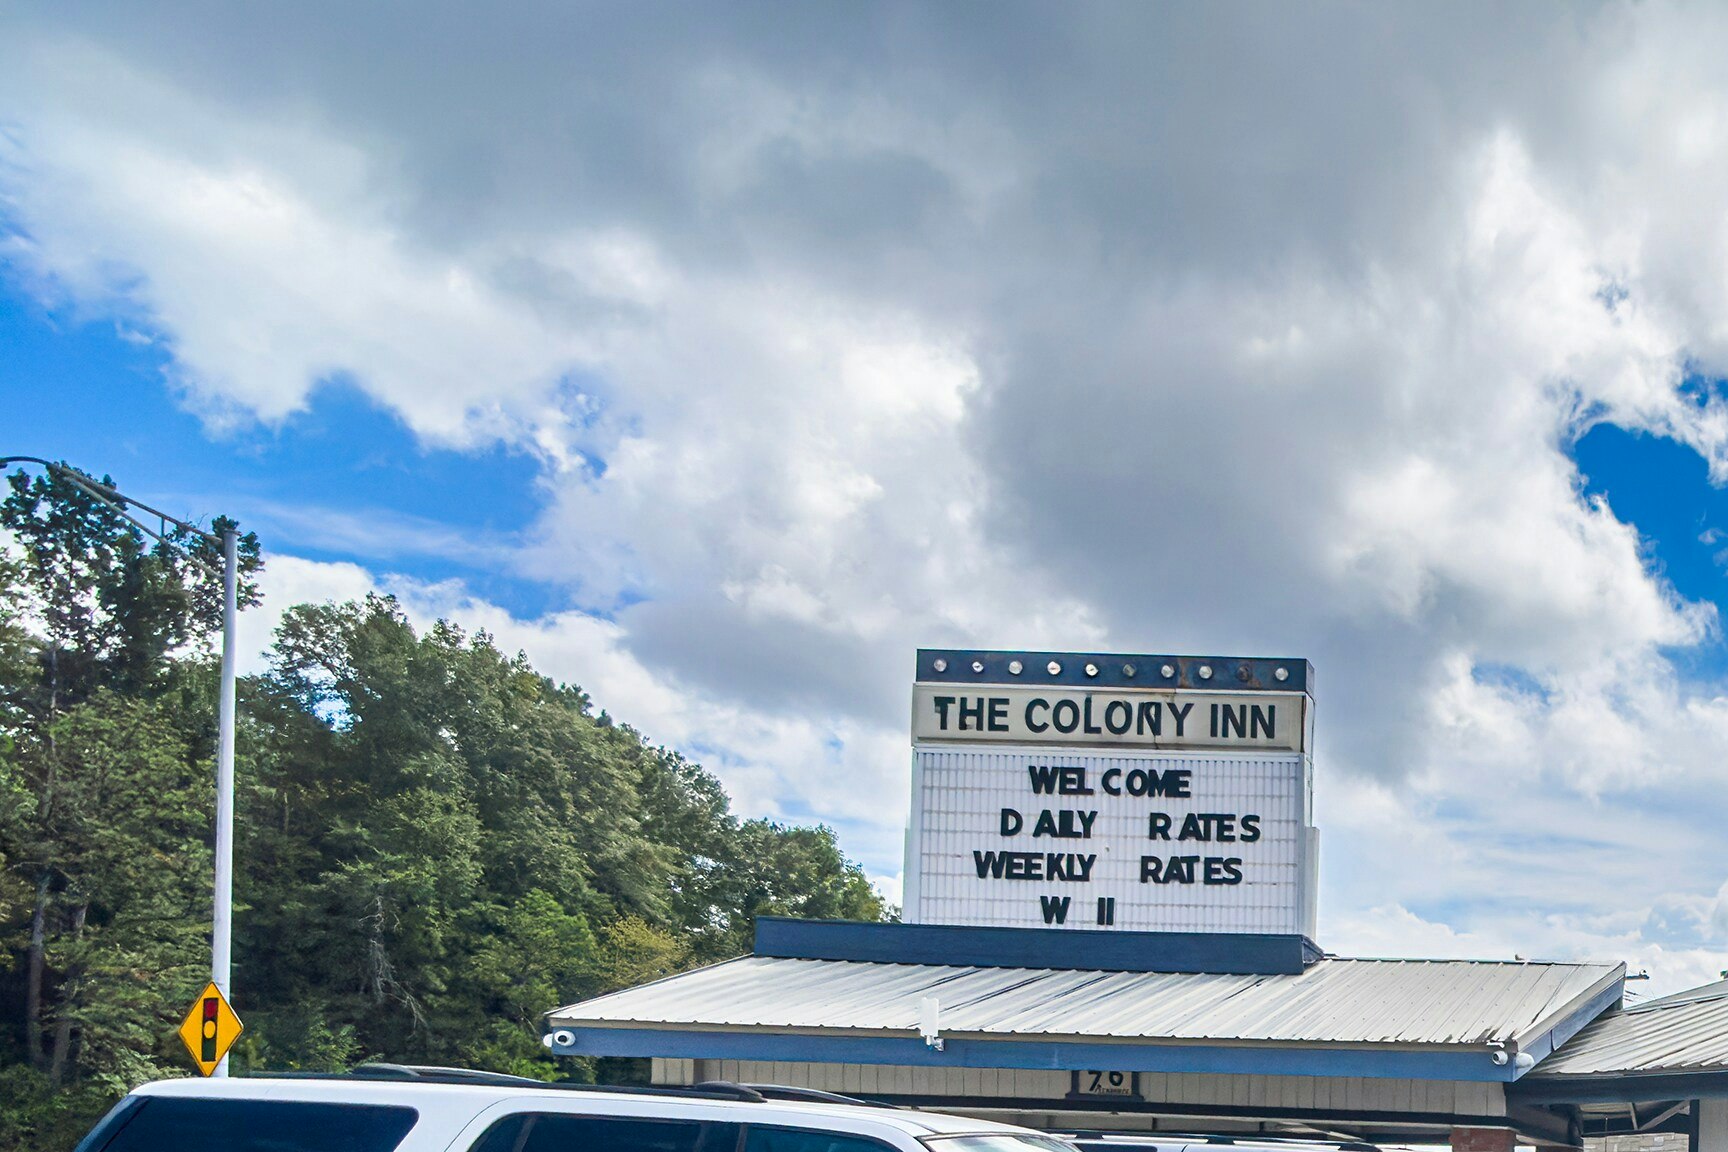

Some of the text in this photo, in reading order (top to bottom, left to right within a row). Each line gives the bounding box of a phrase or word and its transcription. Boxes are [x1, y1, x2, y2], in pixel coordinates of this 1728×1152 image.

[934, 696, 1276, 739] THE COLONY INN
[1148, 812, 1261, 842] RATES
[973, 850, 1243, 886] WEEKLY RATES
